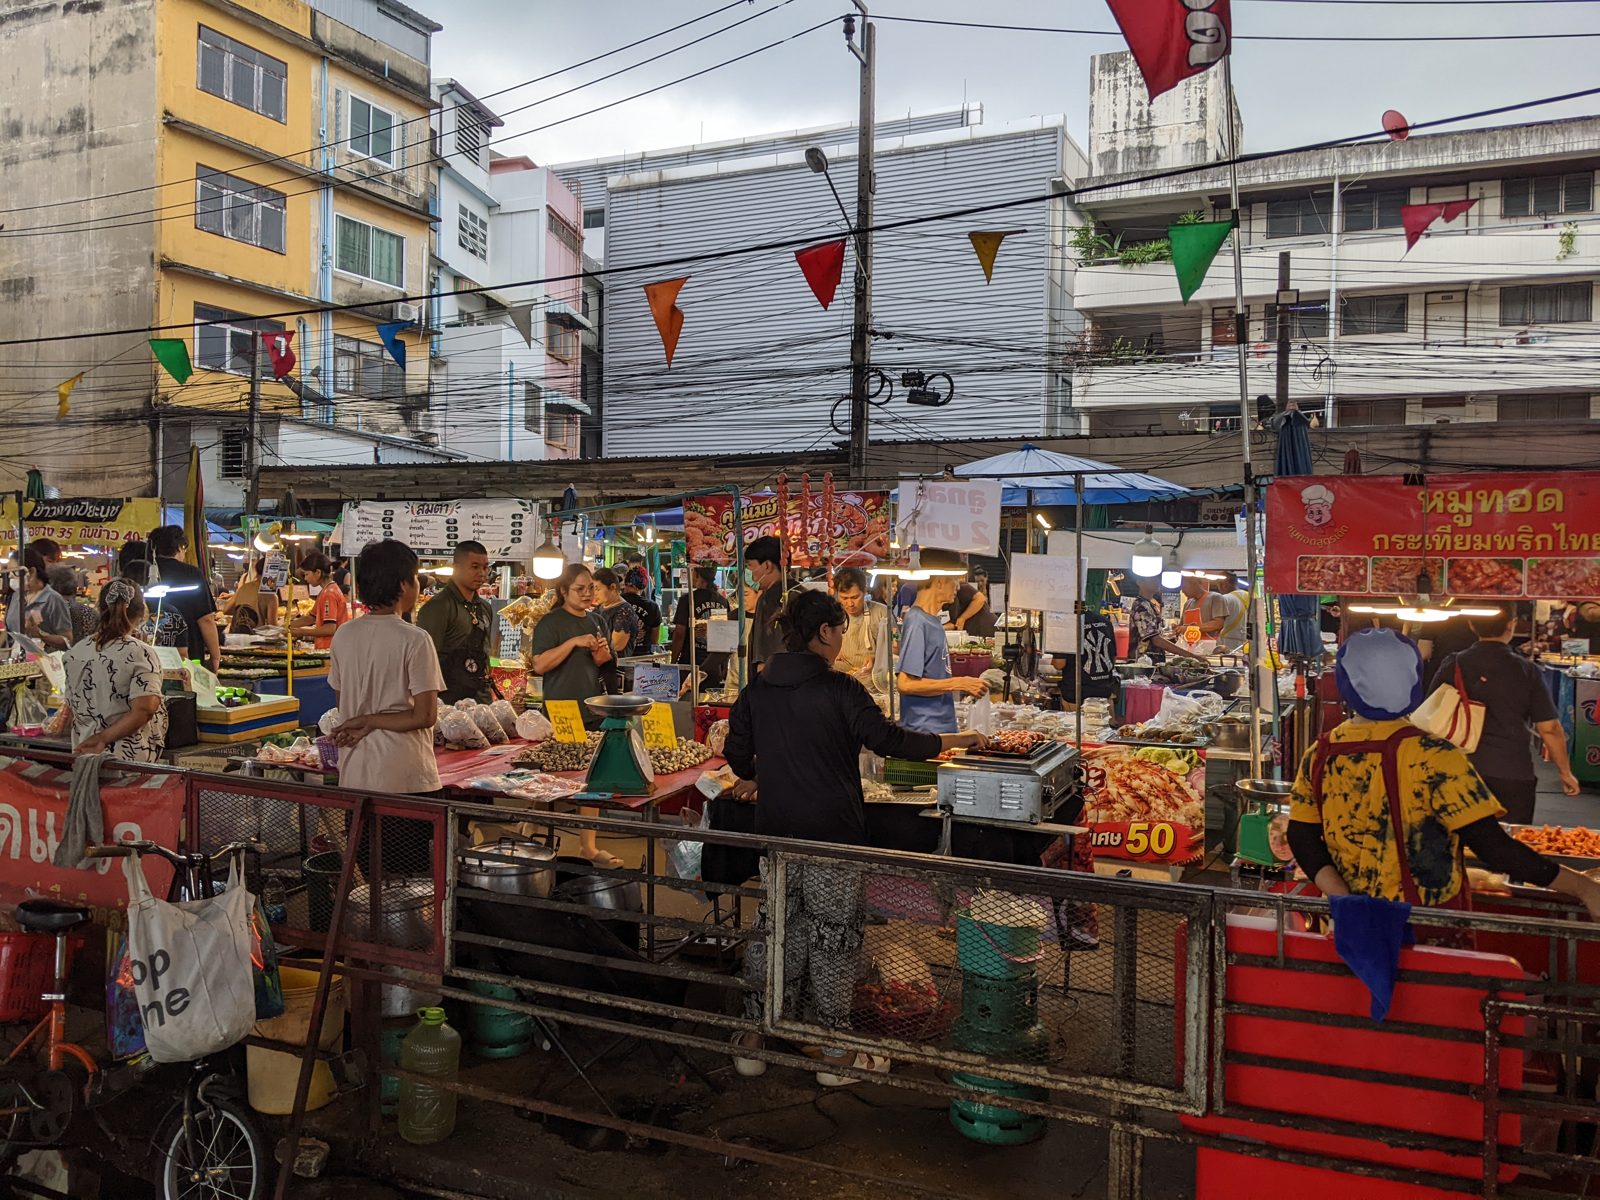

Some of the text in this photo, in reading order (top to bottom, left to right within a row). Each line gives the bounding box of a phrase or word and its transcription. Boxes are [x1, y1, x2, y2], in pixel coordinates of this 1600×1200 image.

[1416, 487, 1564, 527] หมูทอด
[56, 527, 73, 539] 35
[632, 604, 649, 617] ETT
[1091, 822, 1175, 855] เศษ 50
